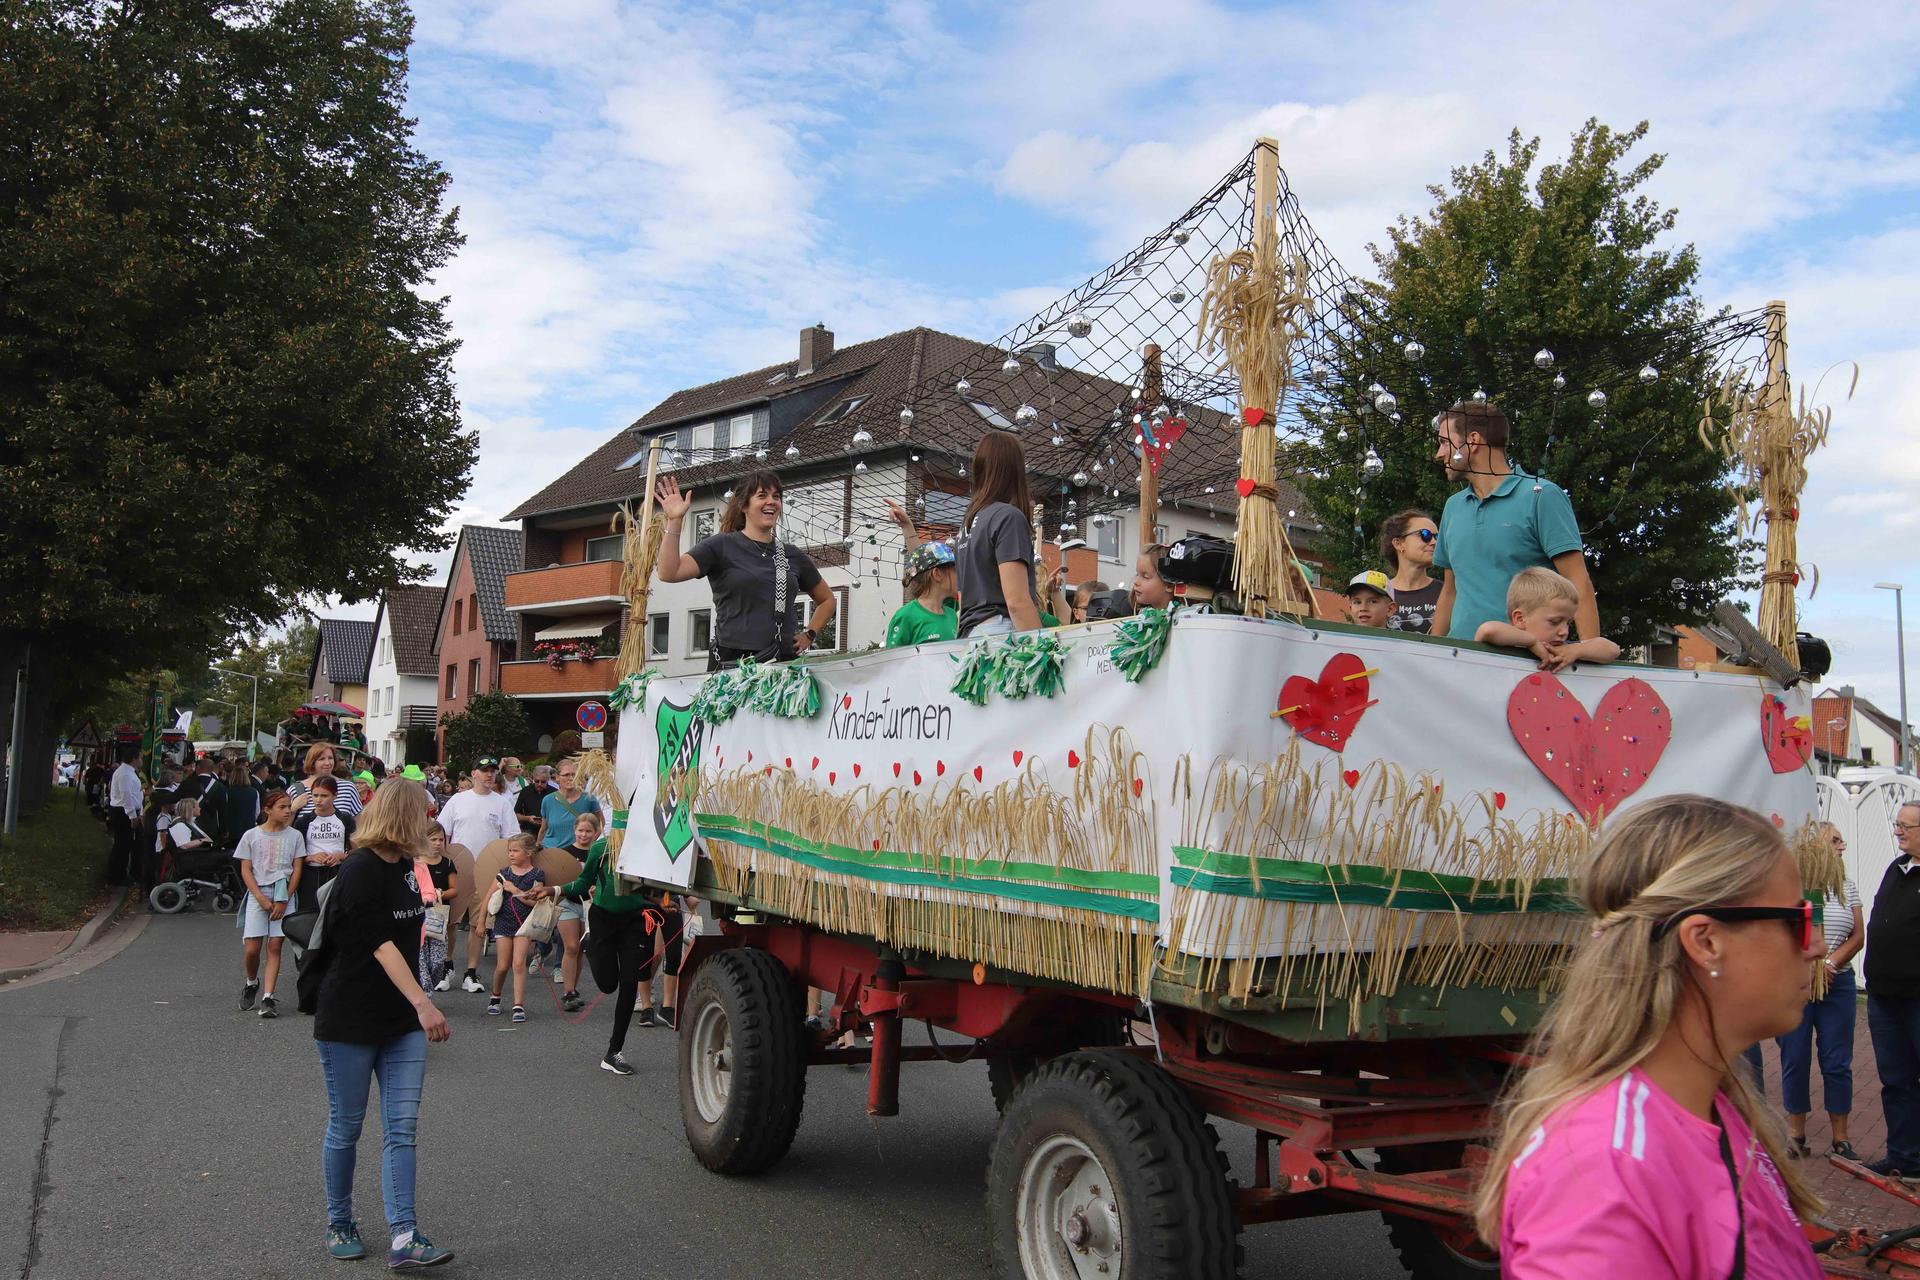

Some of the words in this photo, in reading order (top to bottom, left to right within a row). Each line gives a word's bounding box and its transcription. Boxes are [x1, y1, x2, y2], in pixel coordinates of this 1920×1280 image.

[828, 686, 952, 740] Kinderturnen
[662, 714, 680, 769] TSV
[310, 832, 341, 840] PASADENA
